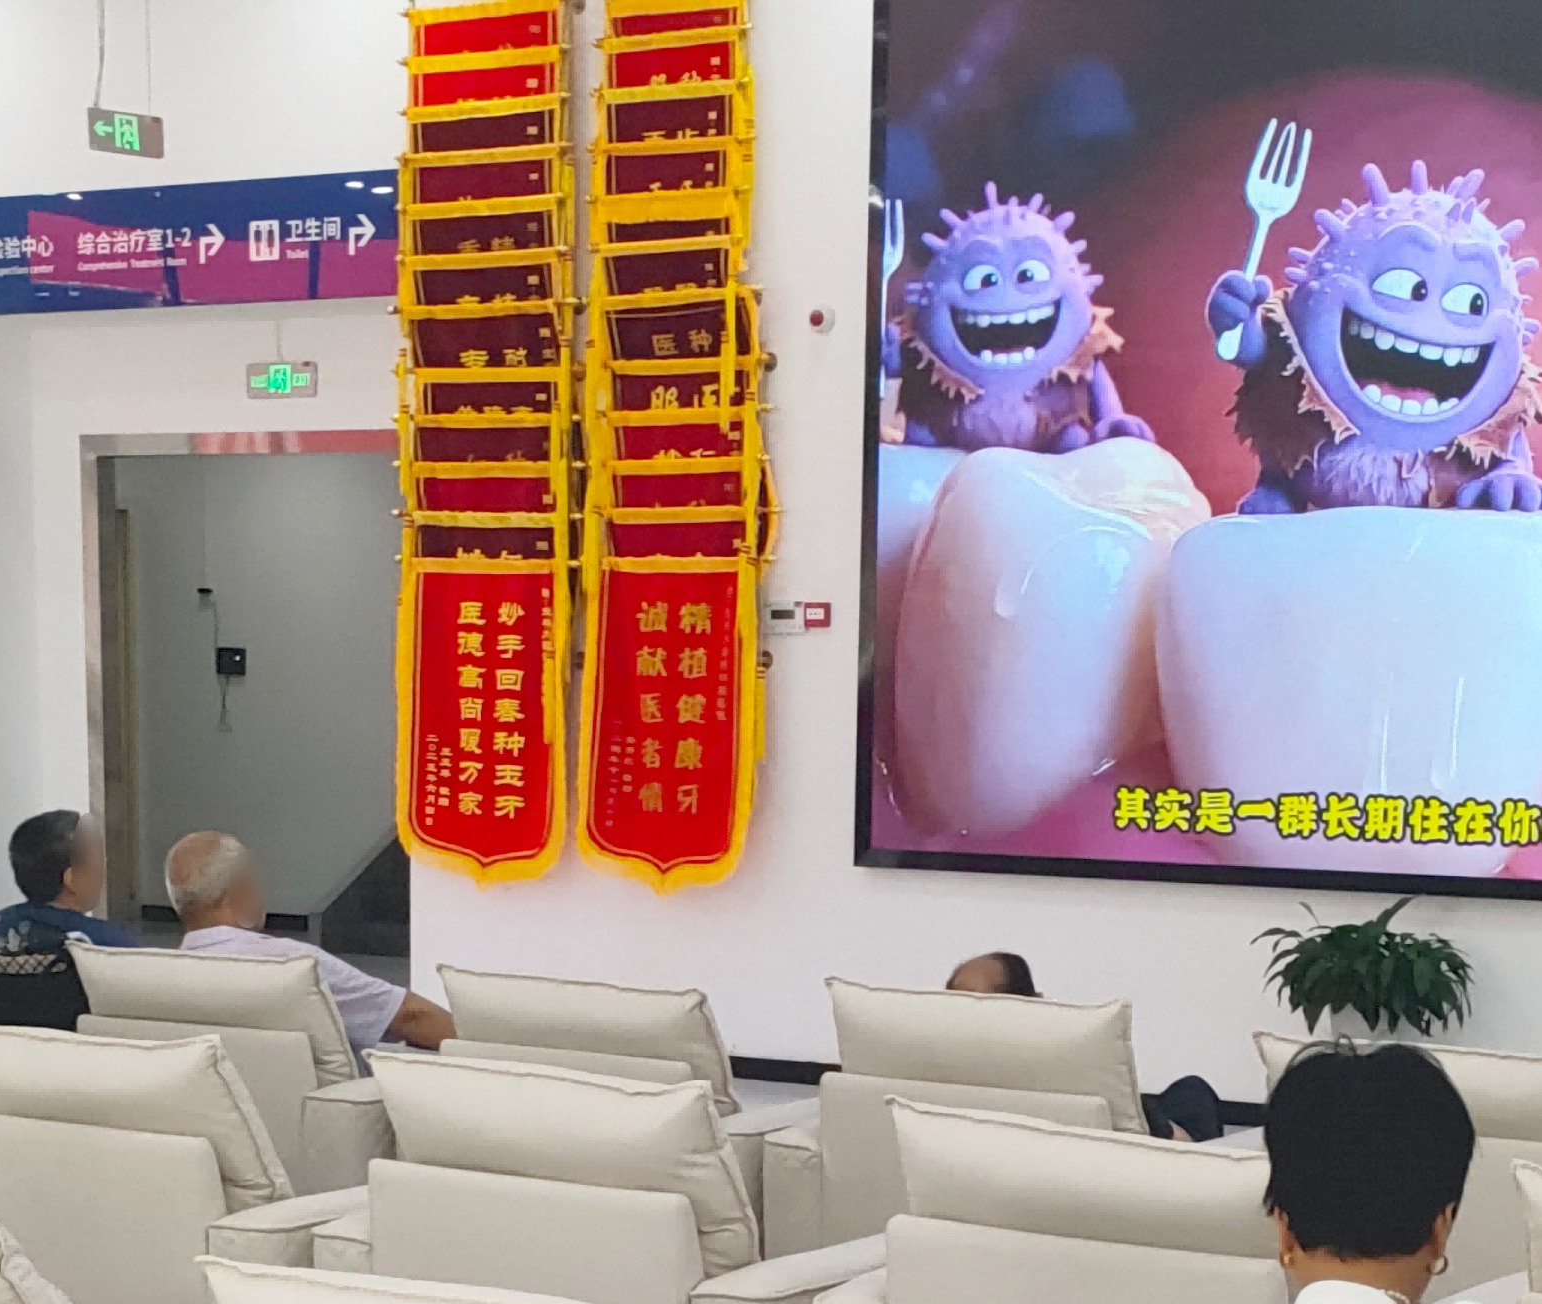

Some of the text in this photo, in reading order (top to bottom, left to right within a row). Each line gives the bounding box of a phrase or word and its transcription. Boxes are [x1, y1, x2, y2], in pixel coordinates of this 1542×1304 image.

[77, 227, 192, 255] 综合治疗室1-2
[285, 216, 341, 242] 卫生间
[456, 602, 487, 816] 医德高尚暖万家
[494, 602, 525, 818] 妙手回春种玉牙
[636, 601, 668, 813] 诚献医者情
[674, 602, 712, 814] 精植健康牙
